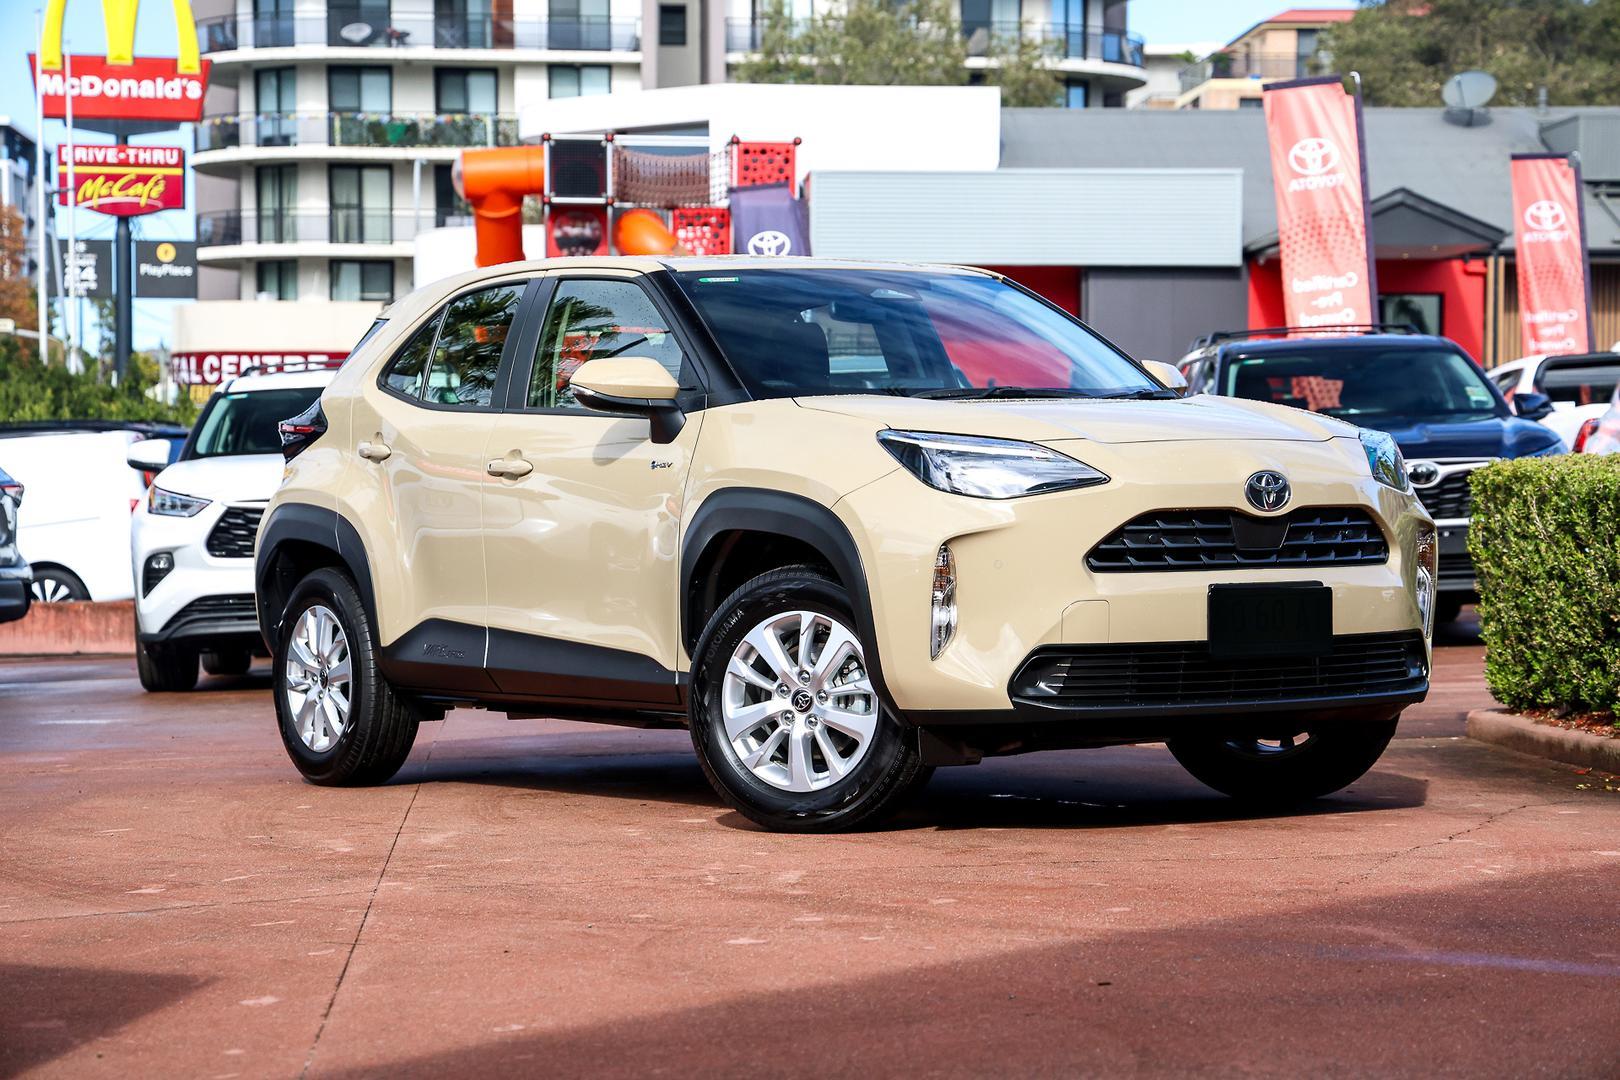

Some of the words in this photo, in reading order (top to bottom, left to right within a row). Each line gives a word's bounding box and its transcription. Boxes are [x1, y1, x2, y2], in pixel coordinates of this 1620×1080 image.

[40, 74, 202, 99] McDonald's
[139, 263, 193, 278] PlayPlace
[704, 608, 745, 665] YOKOHAMA
